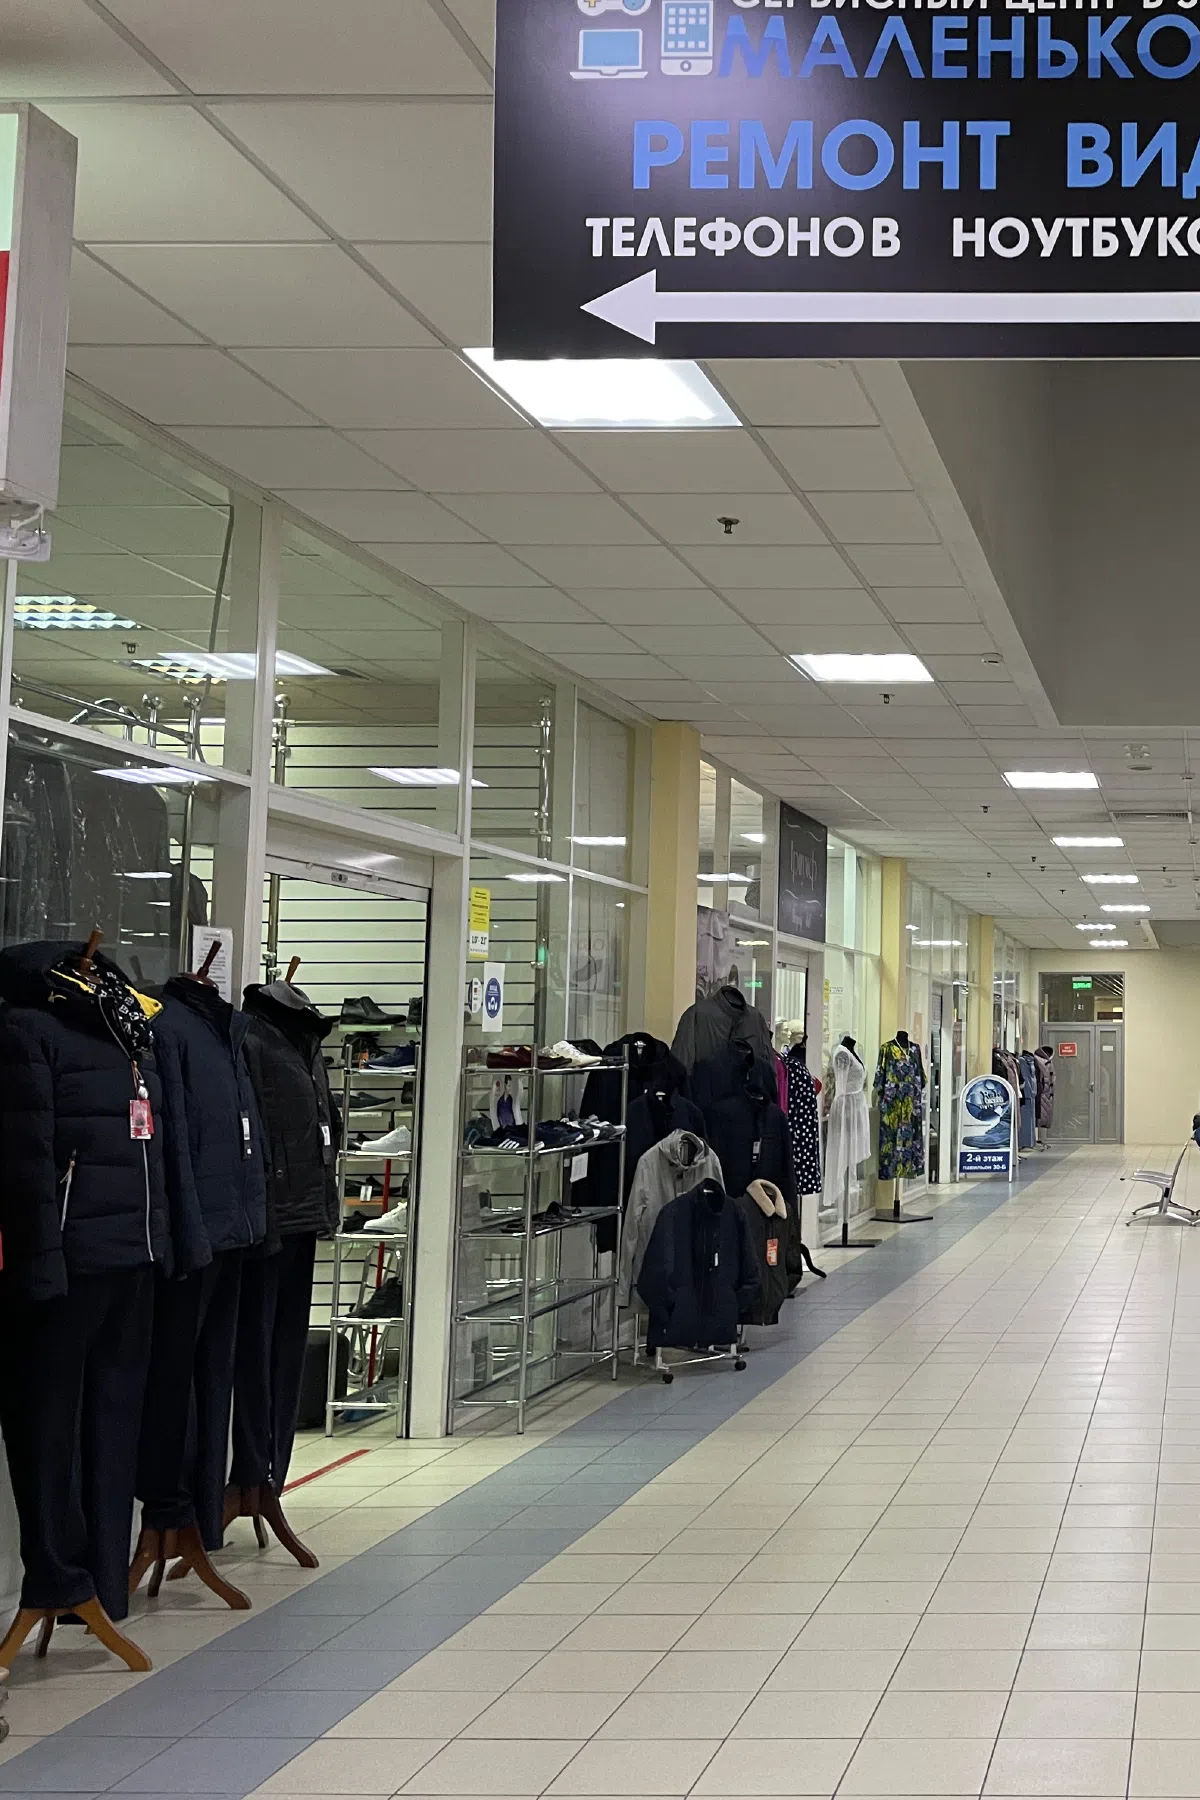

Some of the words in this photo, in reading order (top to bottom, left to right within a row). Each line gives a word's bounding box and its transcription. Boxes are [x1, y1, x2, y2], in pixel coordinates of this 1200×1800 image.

[633, 119, 1010, 190] РЕМОНТ
[586, 216, 900, 257] ТЕЛЕФОНОВ
[966, 1153, 981, 1162] 2-й
